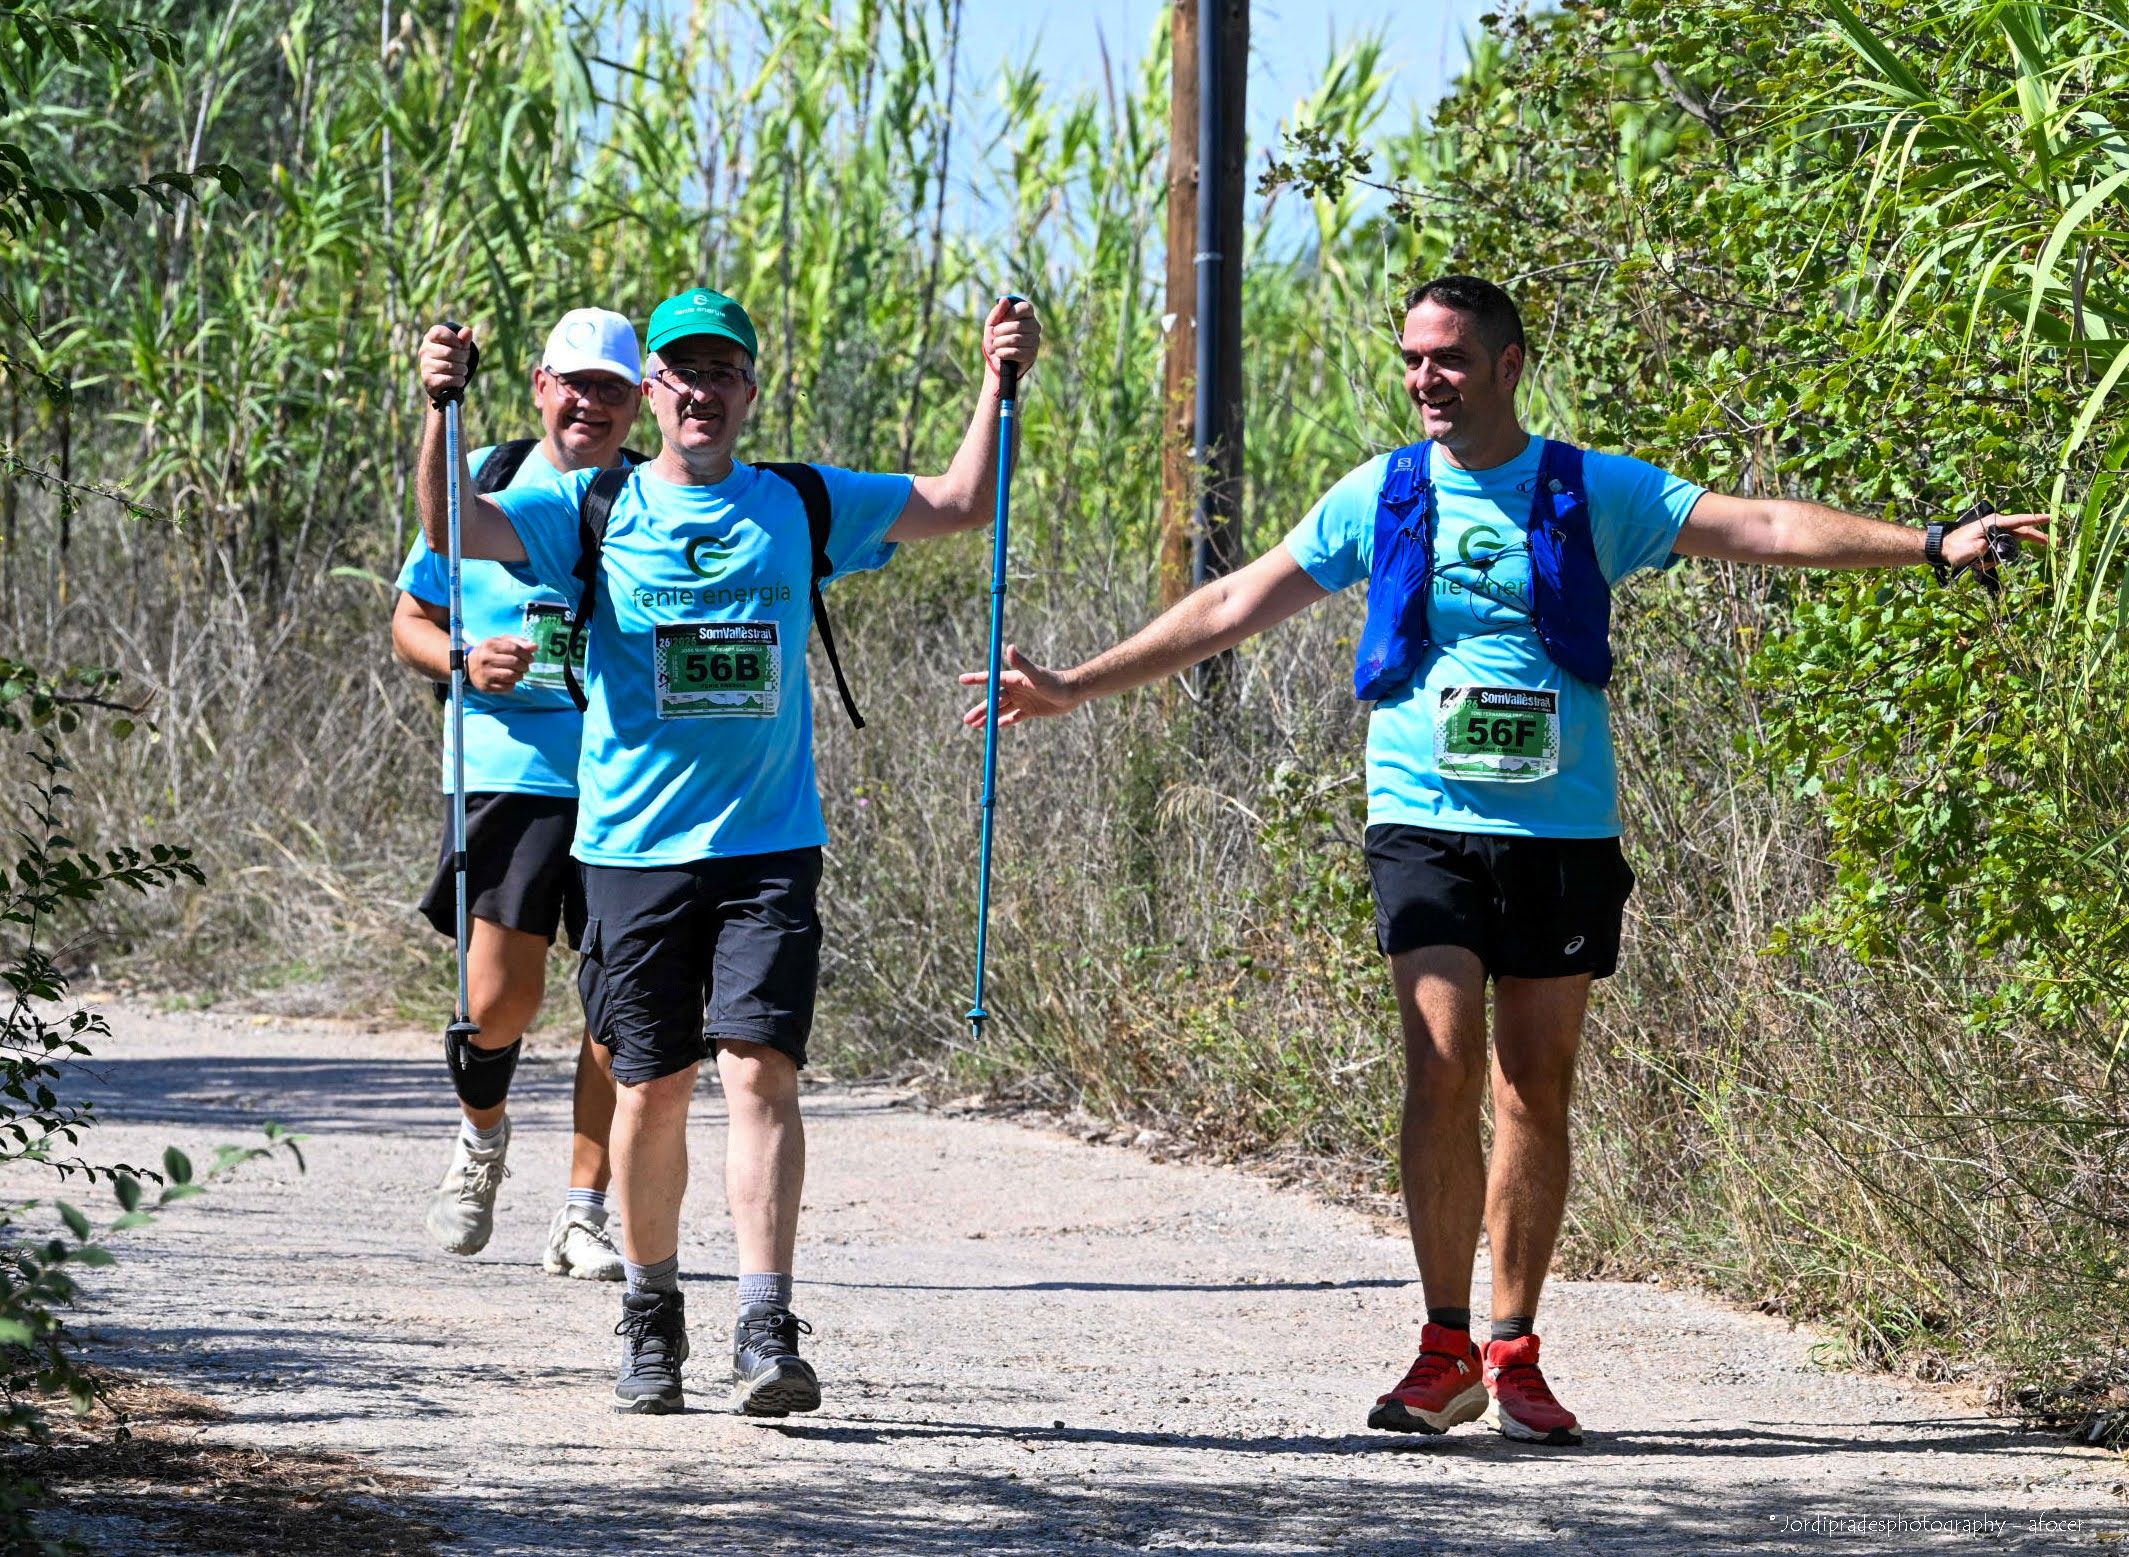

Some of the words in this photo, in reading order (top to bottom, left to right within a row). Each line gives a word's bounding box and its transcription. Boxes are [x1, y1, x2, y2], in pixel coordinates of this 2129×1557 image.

[699, 625, 772, 640] SomVallèstrail
[685, 653, 760, 683] 56B
[1481, 691, 1551, 708] SomVallèstrail
[1466, 717, 1537, 748] 56F
